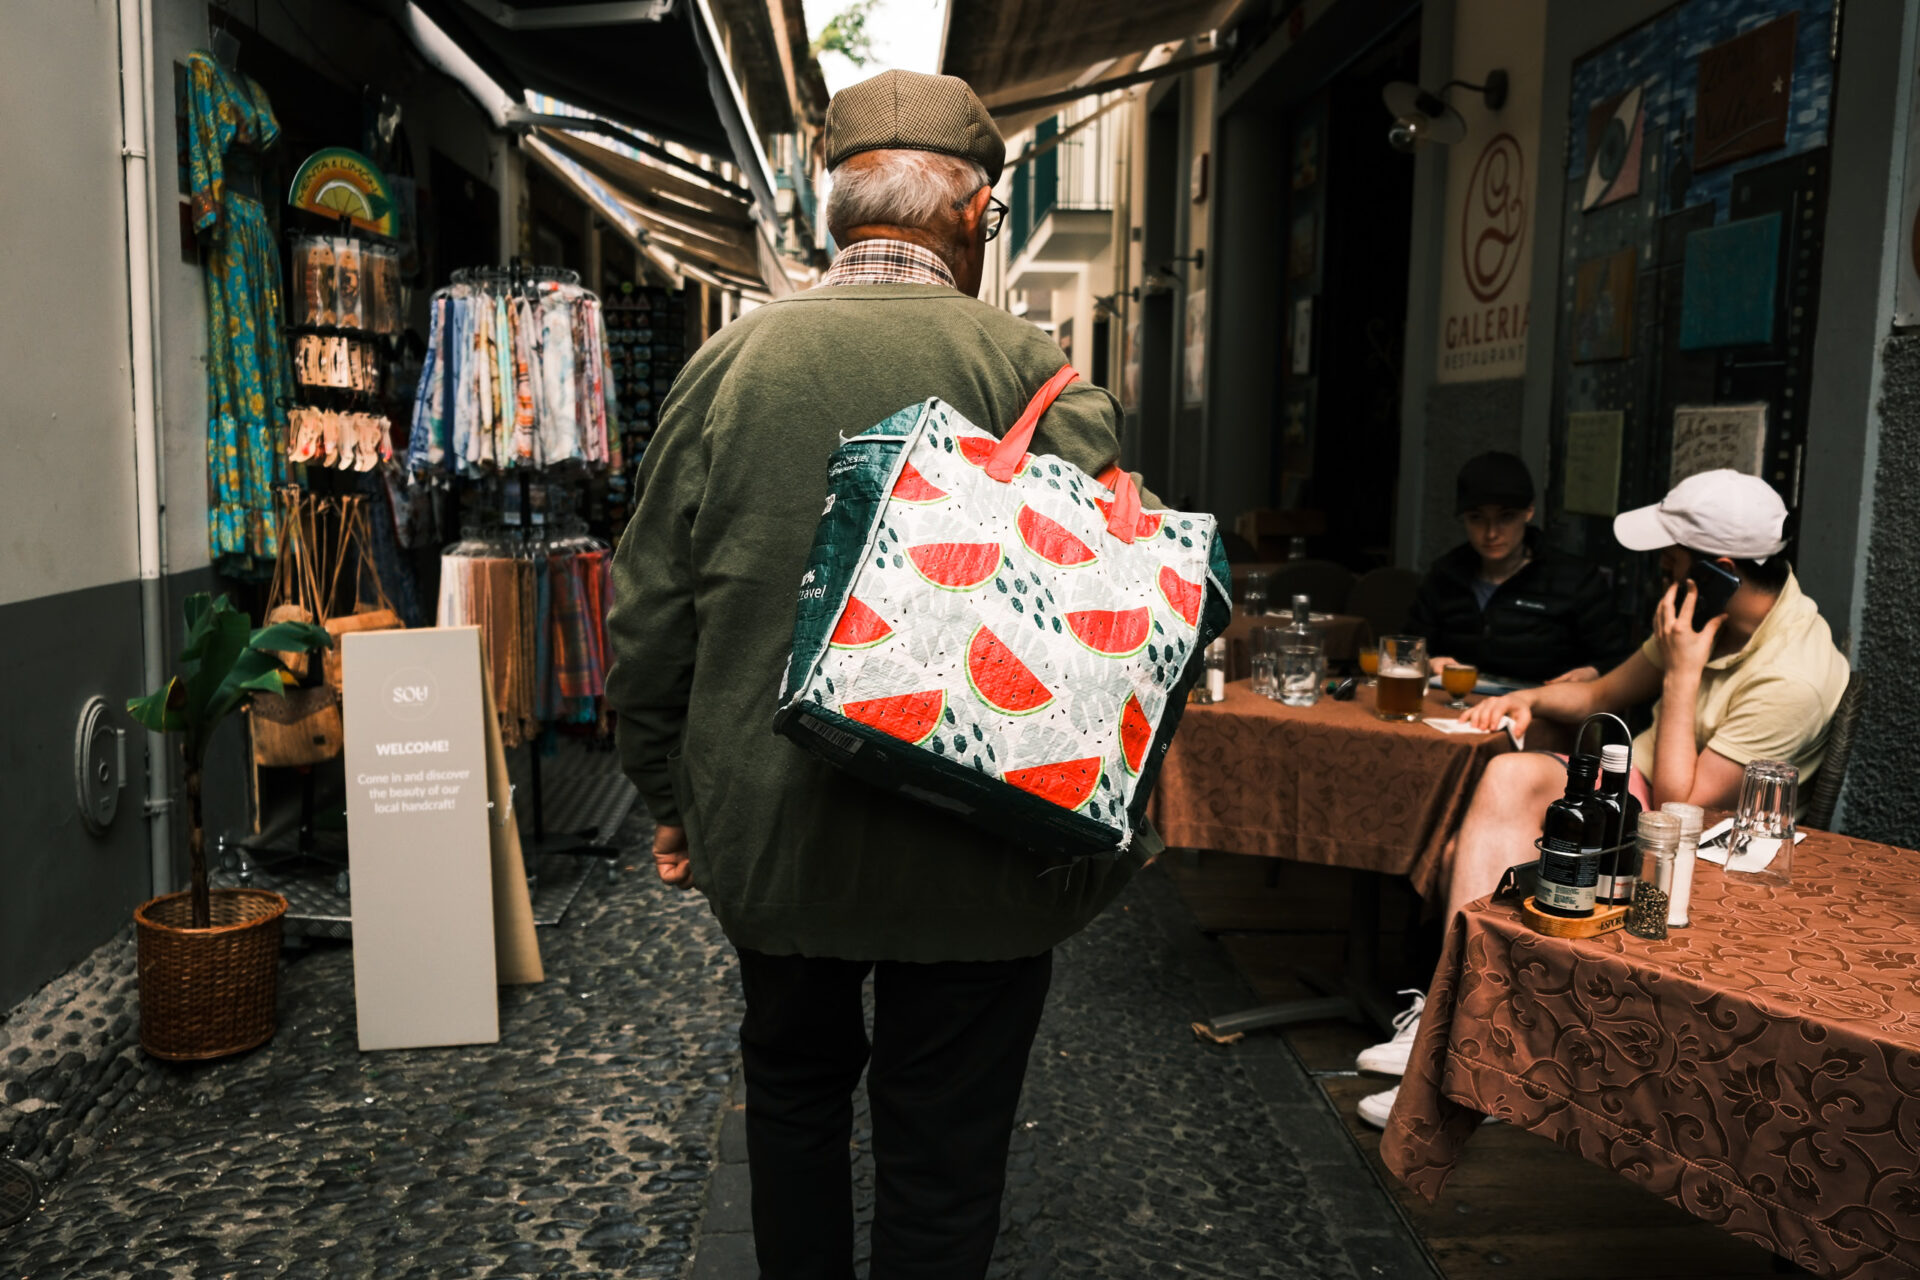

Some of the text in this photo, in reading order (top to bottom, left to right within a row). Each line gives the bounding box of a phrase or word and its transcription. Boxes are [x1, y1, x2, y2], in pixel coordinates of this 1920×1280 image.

[375, 740, 449, 756] WELCOME!
[357, 769, 470, 785] Come in and discover
[369, 784, 461, 799] the beauty of our
[374, 799, 456, 814] local handcraft!
